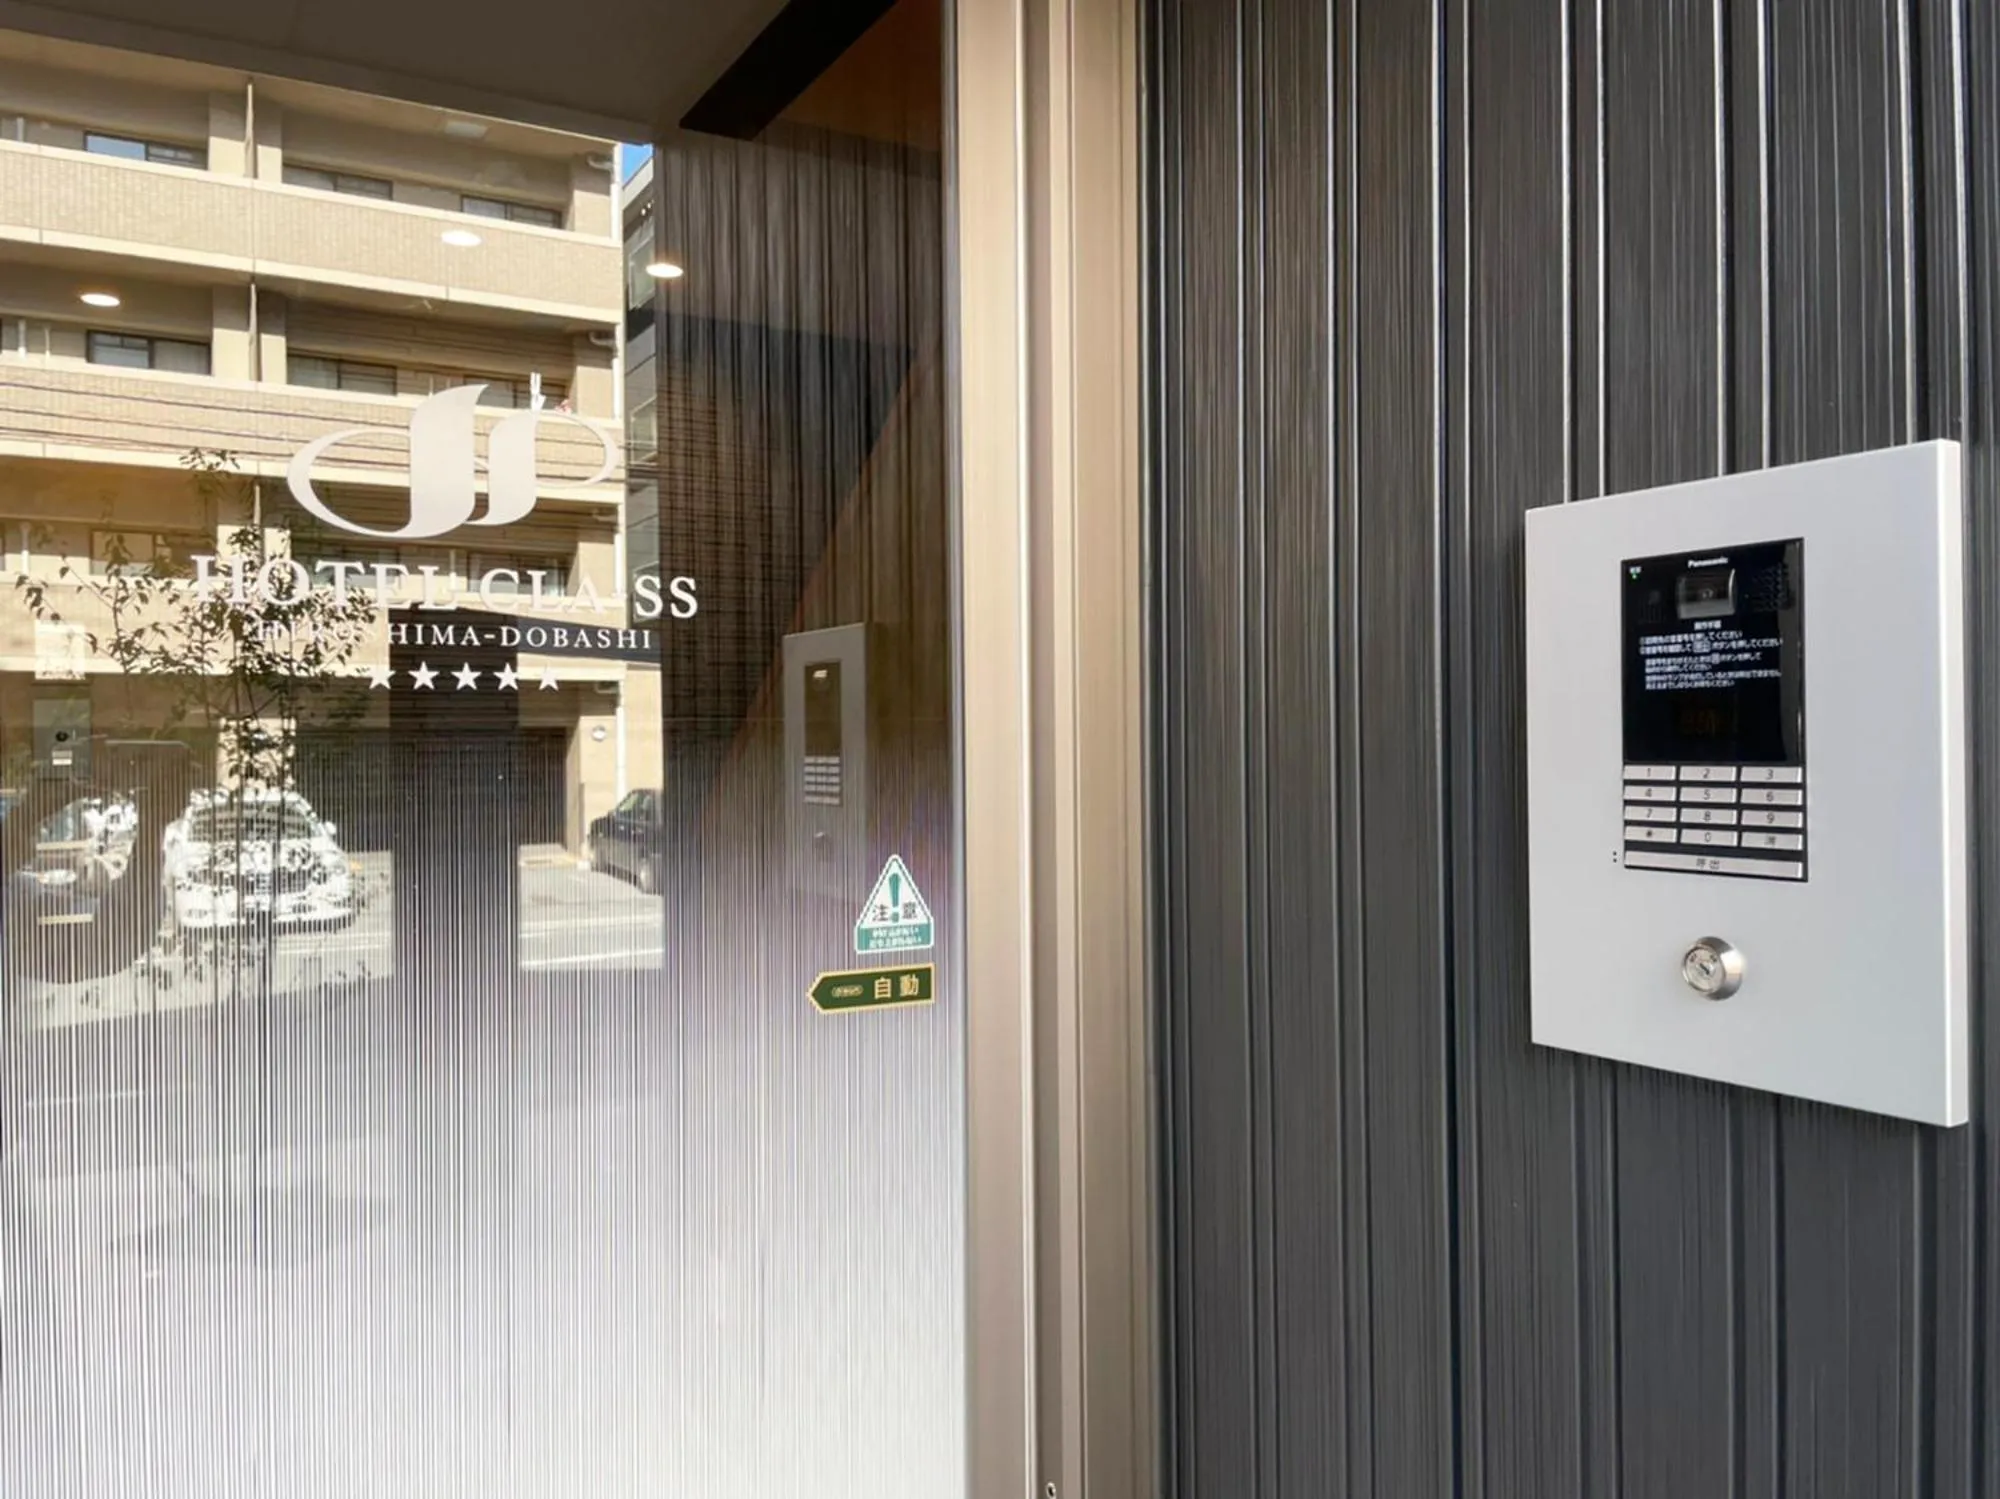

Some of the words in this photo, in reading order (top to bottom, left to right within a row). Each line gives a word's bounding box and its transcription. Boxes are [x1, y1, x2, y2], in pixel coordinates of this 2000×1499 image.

[1687, 556, 1729, 569] Panasonic
[190, 554, 459, 611] HOTEL
[256, 619, 652, 650] HIROHIMA-DOBASHI
[1703, 768, 1710, 779] 2
[1766, 769, 1774, 780] 3
[1645, 788, 1652, 797] 4
[1703, 789, 1711, 800] 5
[1766, 791, 1774, 802] 6
[1646, 809, 1653, 818] 7
[1703, 811, 1711, 821] 8
[1767, 813, 1775, 824] 9
[1704, 832, 1711, 843] 0
[874, 974, 920, 999] 自動
